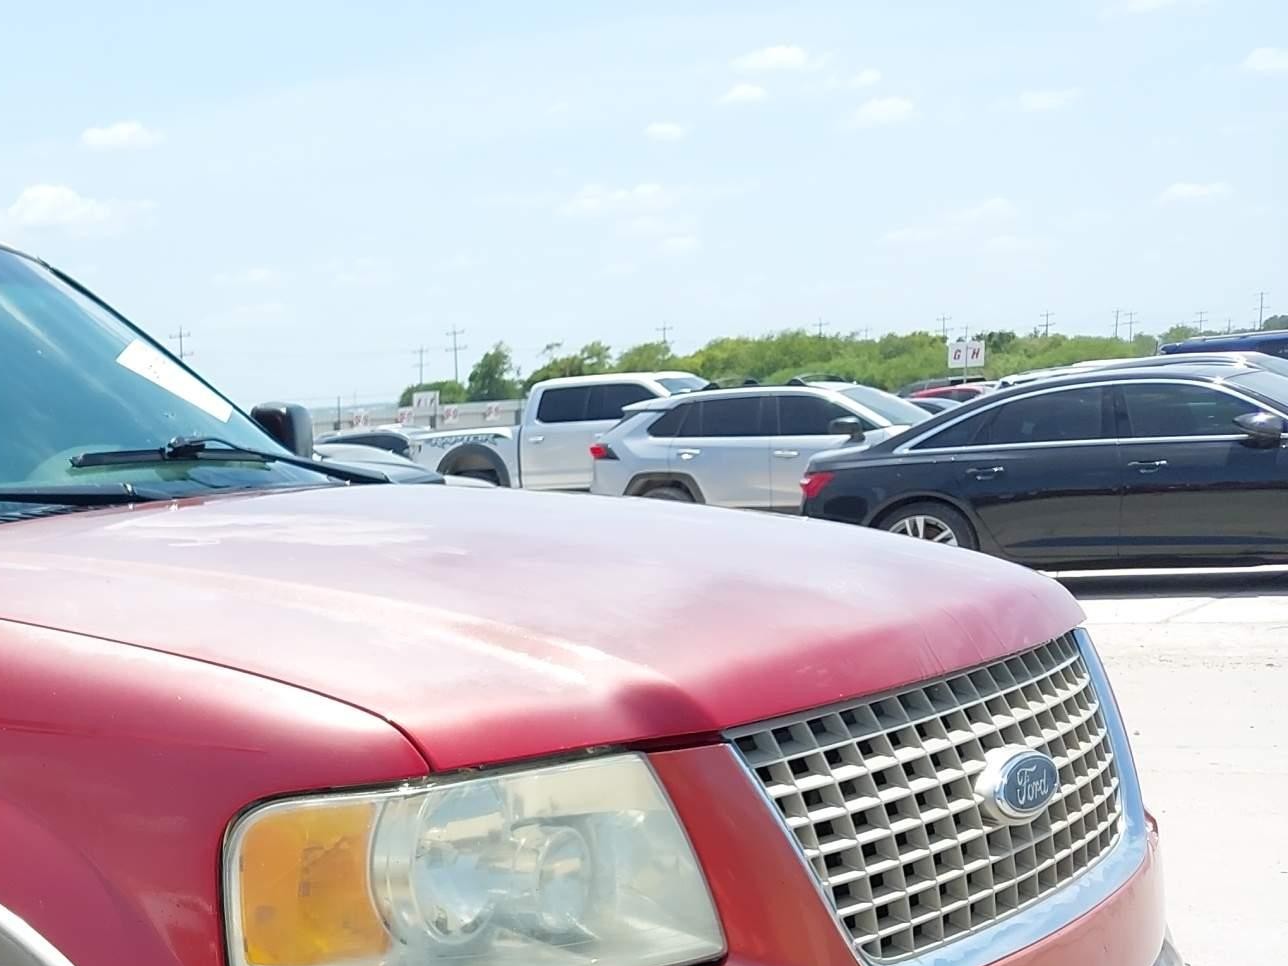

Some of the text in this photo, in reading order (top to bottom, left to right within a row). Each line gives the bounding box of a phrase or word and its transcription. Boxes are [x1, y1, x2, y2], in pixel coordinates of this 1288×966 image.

[953, 348, 980, 360] G H
[1016, 763, 1049, 805] Ford
